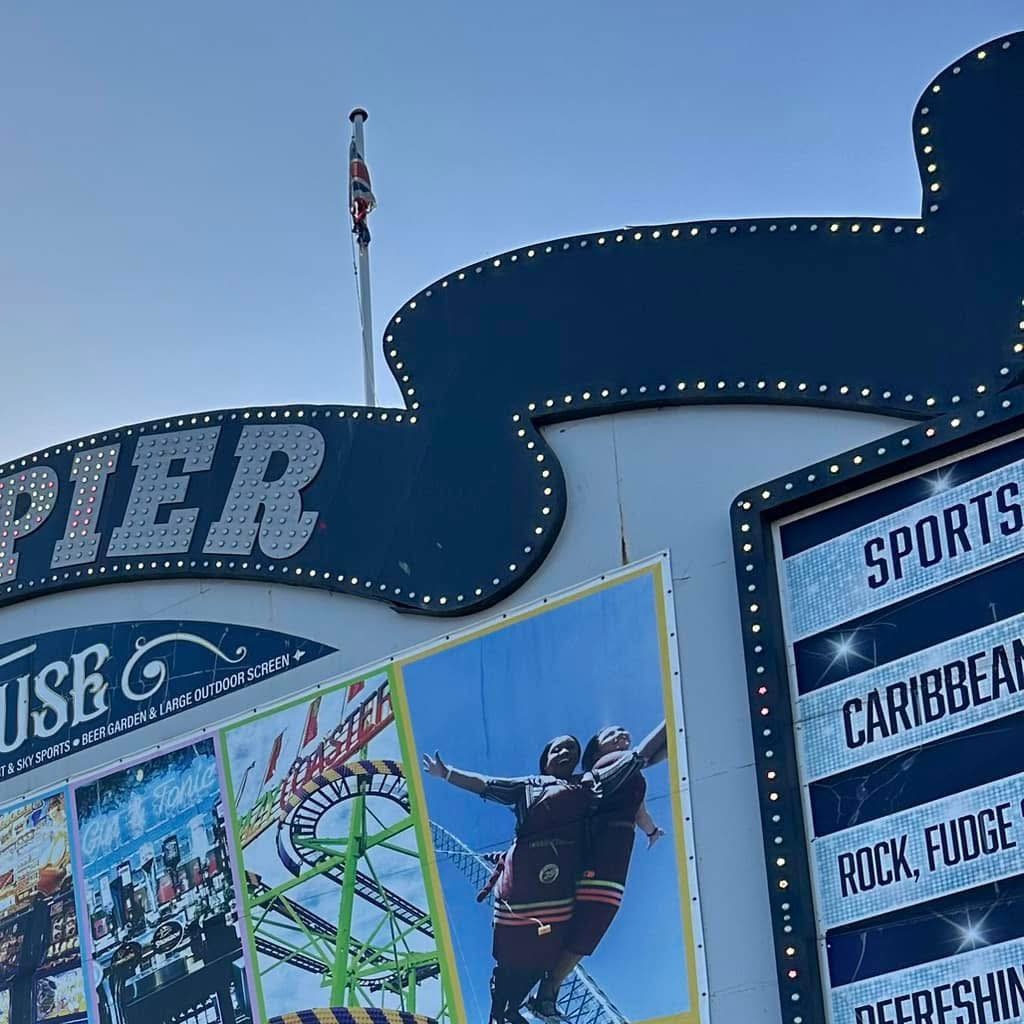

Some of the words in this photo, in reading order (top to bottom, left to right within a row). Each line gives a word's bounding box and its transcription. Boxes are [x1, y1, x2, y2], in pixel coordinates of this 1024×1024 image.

[863, 482, 1024, 590] SPORTS
[17, 754, 35, 771] SKY
[35, 740, 70, 764] SPORTS
[82, 728, 106, 746] BEER
[107, 712, 147, 736] GARDEN
[149, 707, 157, 719] &
[159, 692, 192, 716] LARGE
[194, 671, 245, 702] OUTDOOR
[246, 653, 290, 681] SCREEN
[838, 834, 920, 898] ROCK,
[925, 802, 1017, 872] FUDGE
